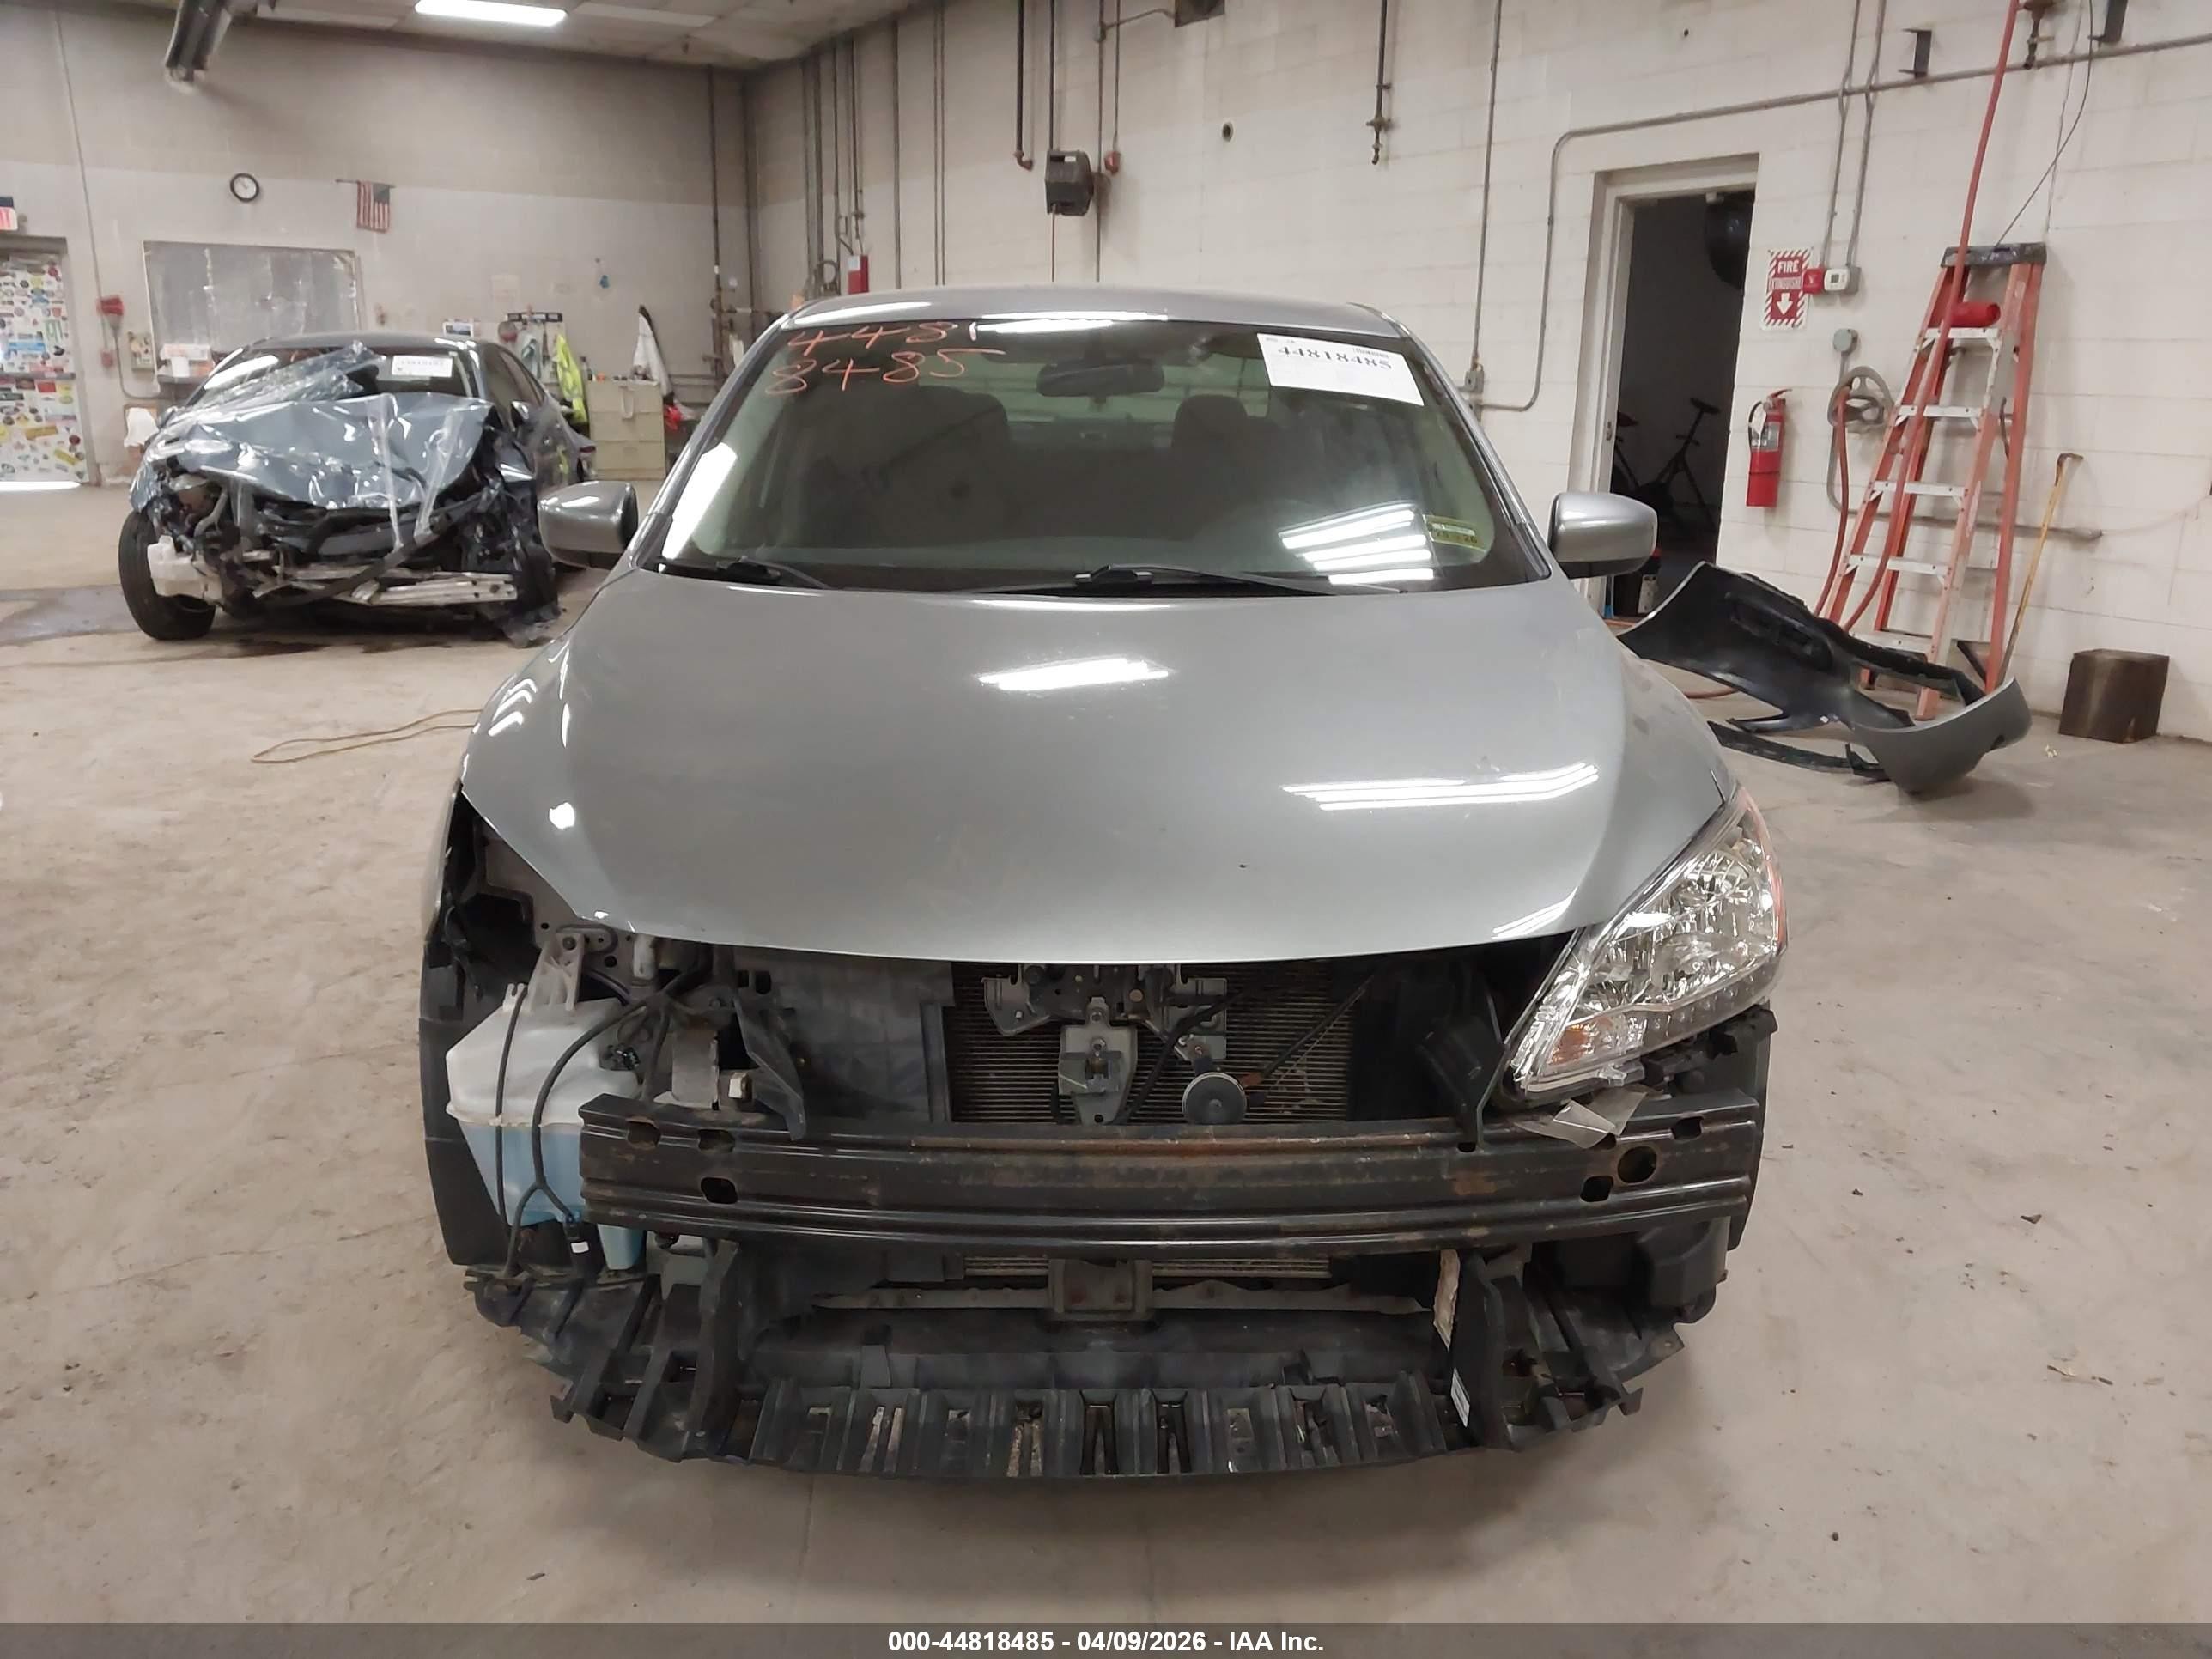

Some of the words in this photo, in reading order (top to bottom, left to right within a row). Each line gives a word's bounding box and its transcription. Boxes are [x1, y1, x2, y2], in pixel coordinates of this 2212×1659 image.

[1777, 258, 1800, 274] FIRE
[787, 321, 977, 356] 4481
[764, 348, 1006, 395] 8485
